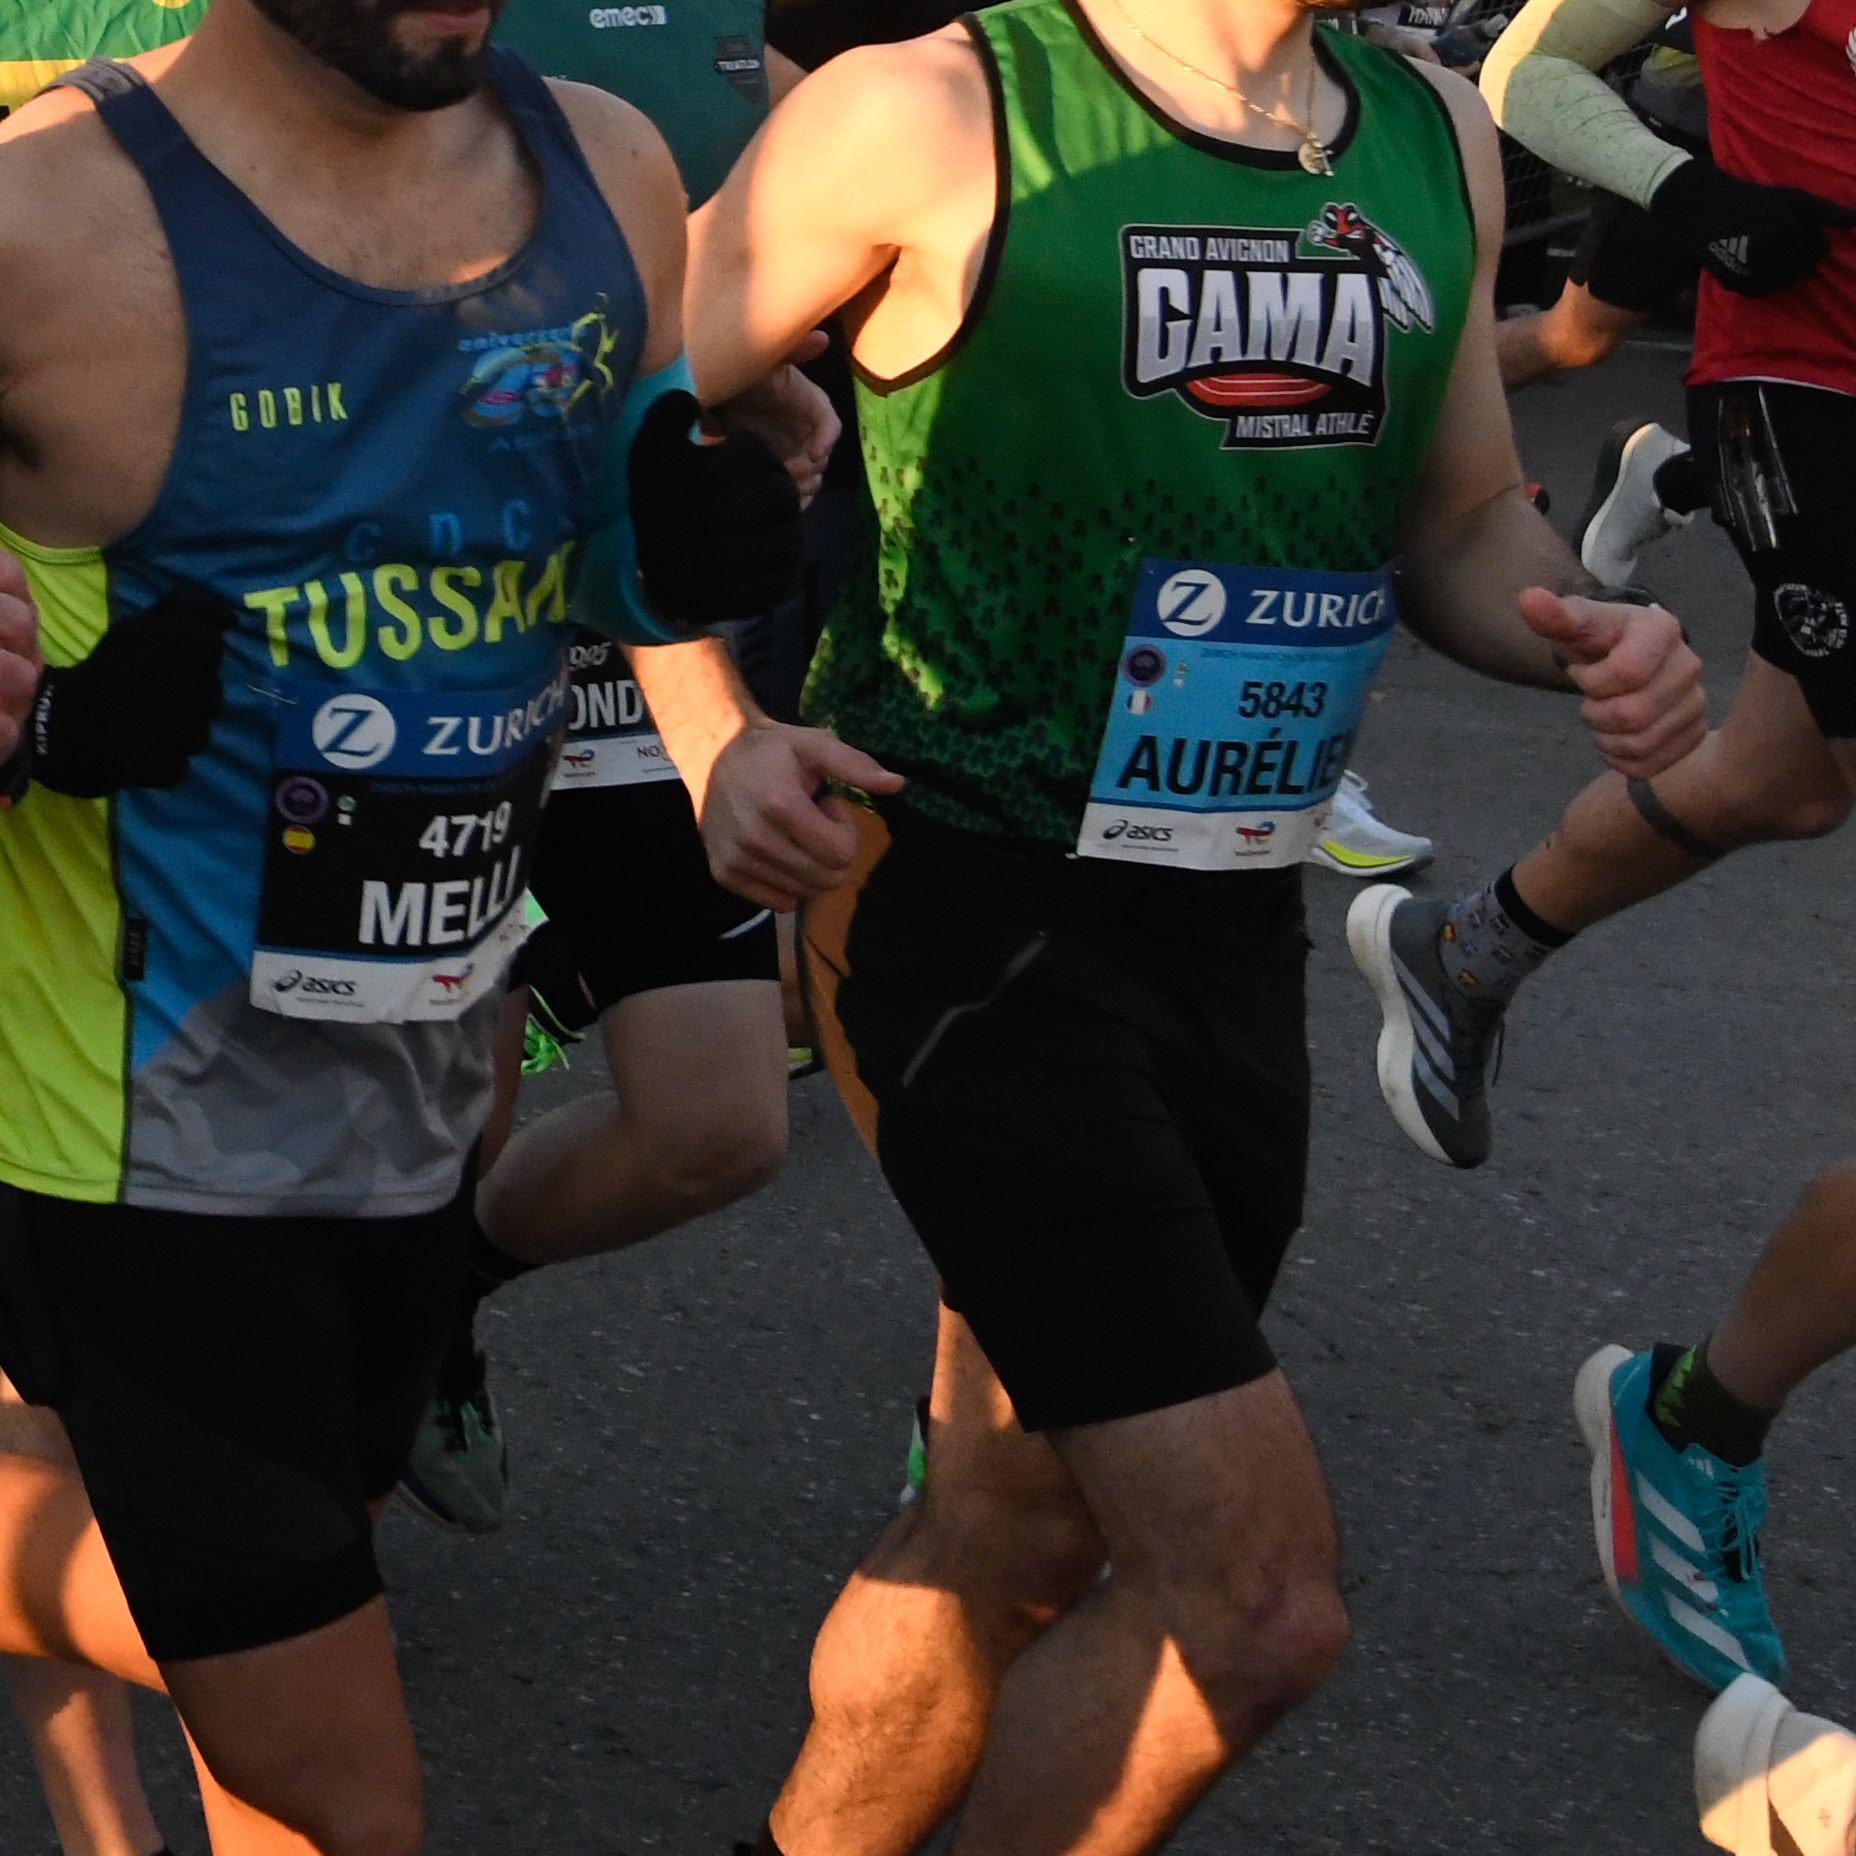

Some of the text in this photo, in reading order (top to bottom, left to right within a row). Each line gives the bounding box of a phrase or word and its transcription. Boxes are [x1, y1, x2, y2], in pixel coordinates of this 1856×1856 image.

[1129, 235, 1290, 263] GRAND AVIGNON
[1136, 267, 1375, 388] GAMA
[229, 382, 348, 432] GOBIK
[1235, 409, 1375, 439] MISTRAL ATHLÉ
[1238, 680, 1327, 720] 5843
[419, 800, 513, 858] 4719
[1125, 825, 1173, 842] asics
